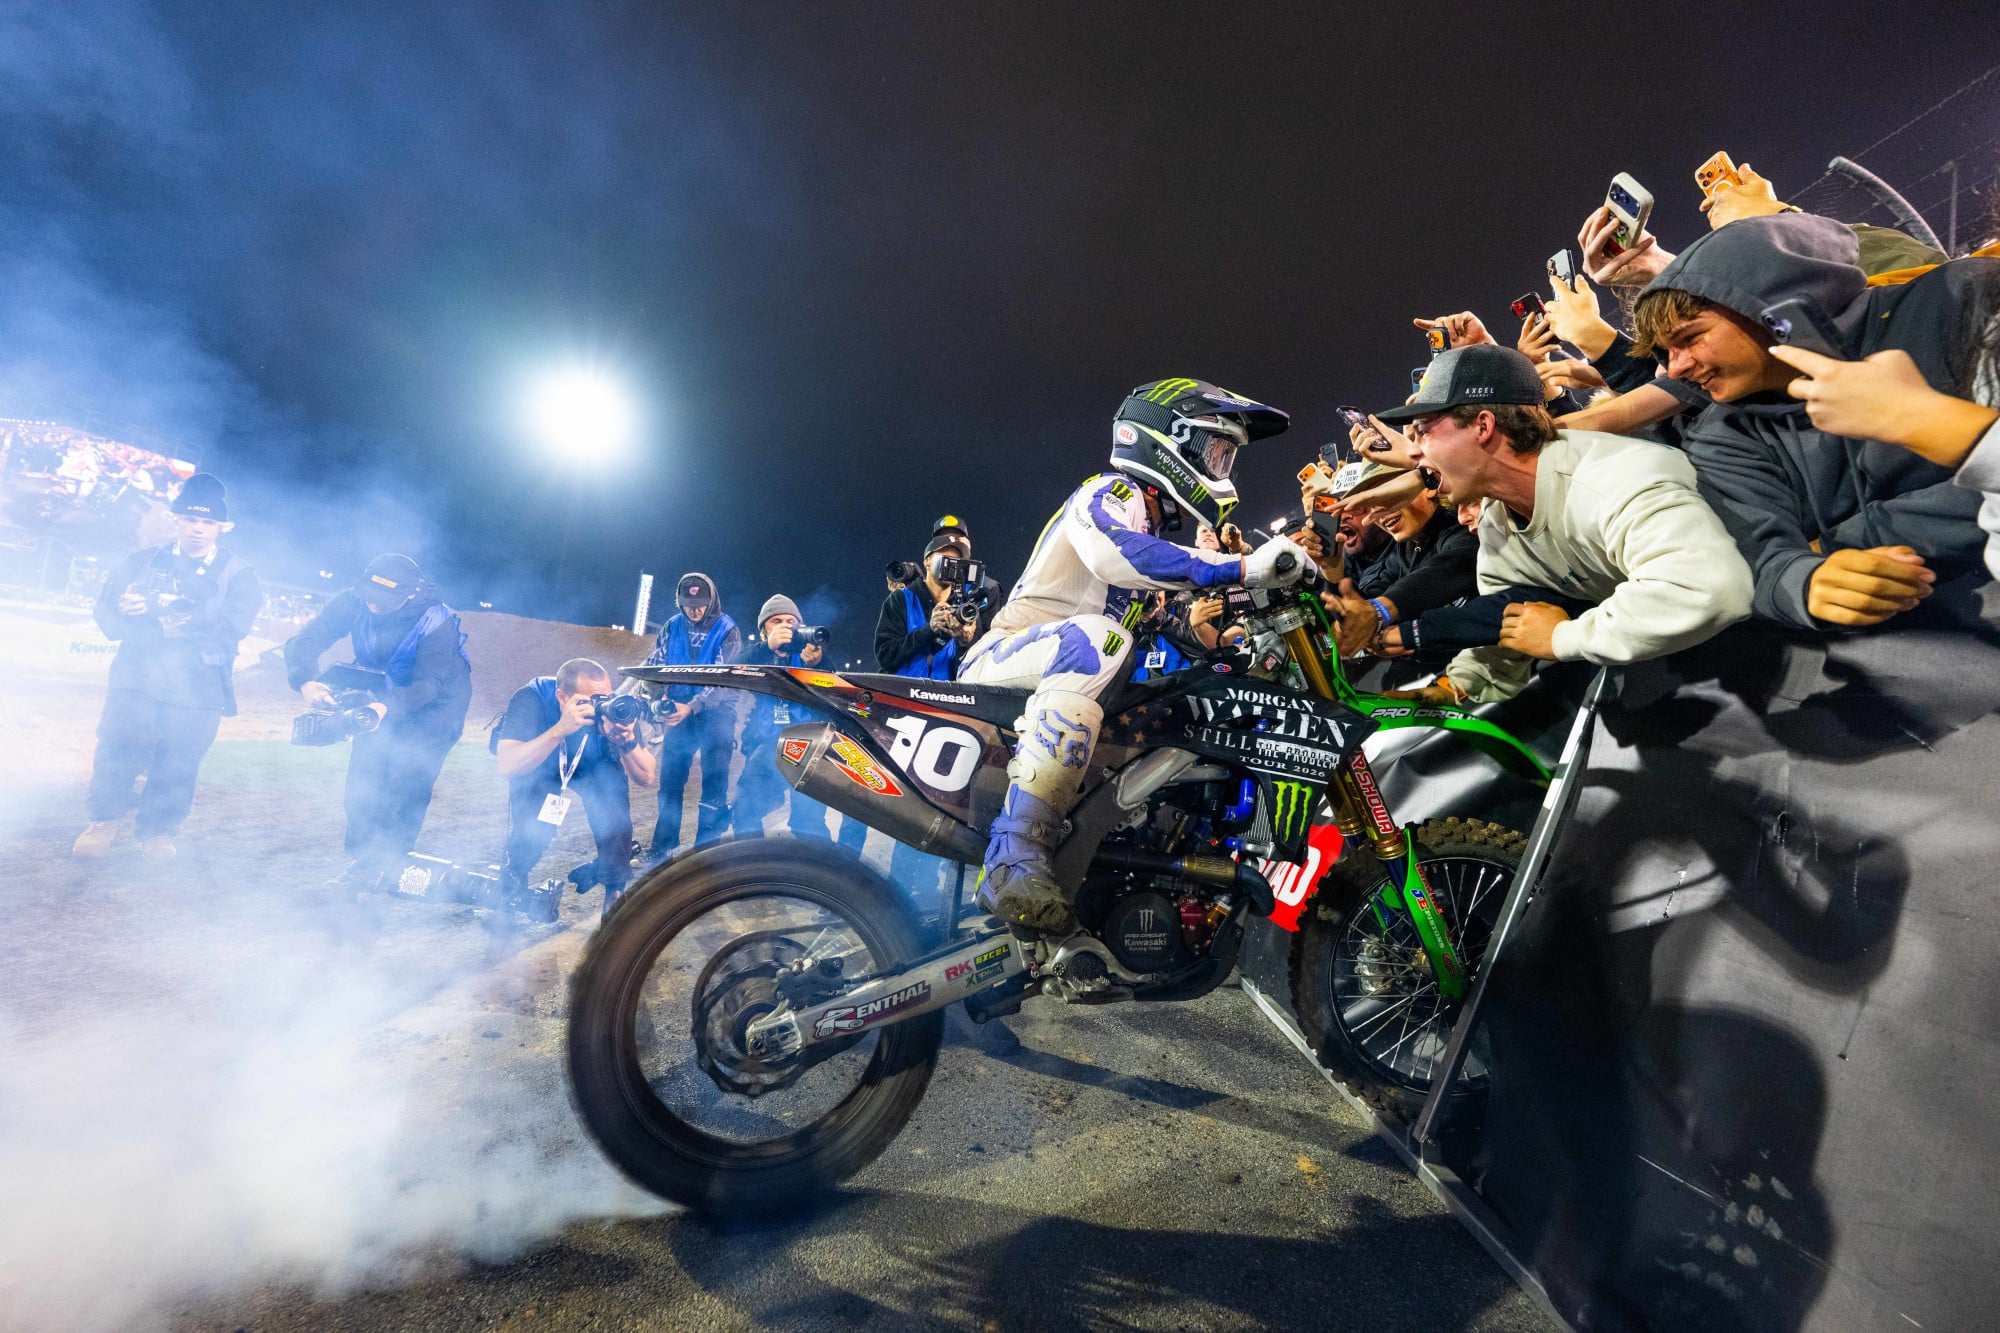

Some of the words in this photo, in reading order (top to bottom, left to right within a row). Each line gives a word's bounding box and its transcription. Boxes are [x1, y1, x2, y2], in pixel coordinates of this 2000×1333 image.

[69, 640, 119, 654] Kawa
[910, 688, 976, 705] Kawasaki
[1225, 687, 1316, 713] MORGAN
[1370, 707, 1412, 719] PRO
[1183, 723, 1252, 751] STILL
[885, 715, 982, 792] 10
[1239, 755, 1288, 770] TOUR
[1293, 765, 1326, 778] 2026
[1355, 771, 1395, 834] SHOWA
[1410, 889, 1430, 910] JE
[1124, 938, 1167, 947] Kawasaki
[945, 960, 975, 983] RK
